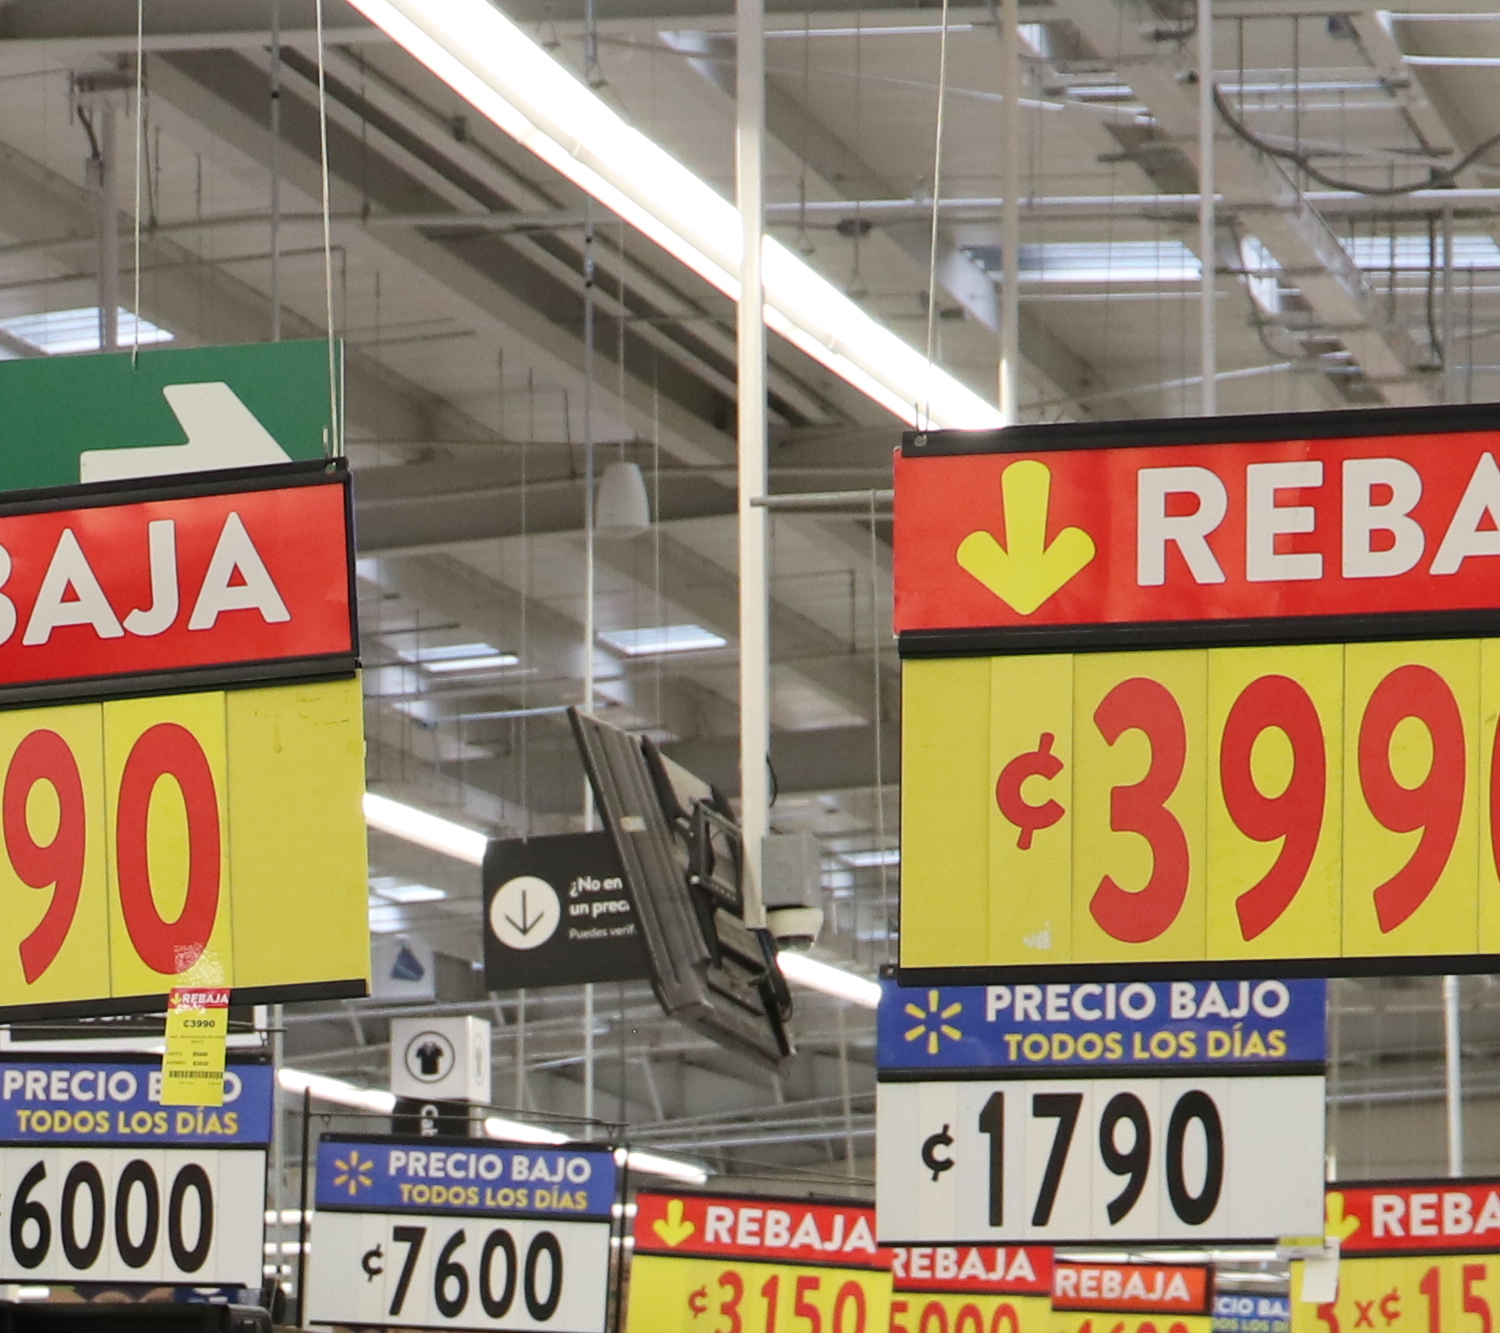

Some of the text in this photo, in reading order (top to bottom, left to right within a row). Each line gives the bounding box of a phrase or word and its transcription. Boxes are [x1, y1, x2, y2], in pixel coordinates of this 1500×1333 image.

[569, 876, 600, 898] ¿No
[570, 900, 589, 917] un
[182, 993, 229, 1004] REBAJA
[985, 979, 1290, 1023] PRECIO BAJO
[1004, 1022, 1287, 1061] TODOS LOS DÍAS
[3, 1071, 243, 1103] PRECIO BO
[17, 1106, 241, 1137] TODOS LOS DÍAS
[388, 1151, 592, 1185] PRECIO BAJO
[921, 1087, 1225, 1227] ¢1790
[400, 1183, 590, 1211] TODOS LOS DÍAS
[705, 1206, 878, 1254] REBAJA
[361, 1225, 564, 1324] ¢7600
[1055, 1267, 1190, 1302] REBAJA
